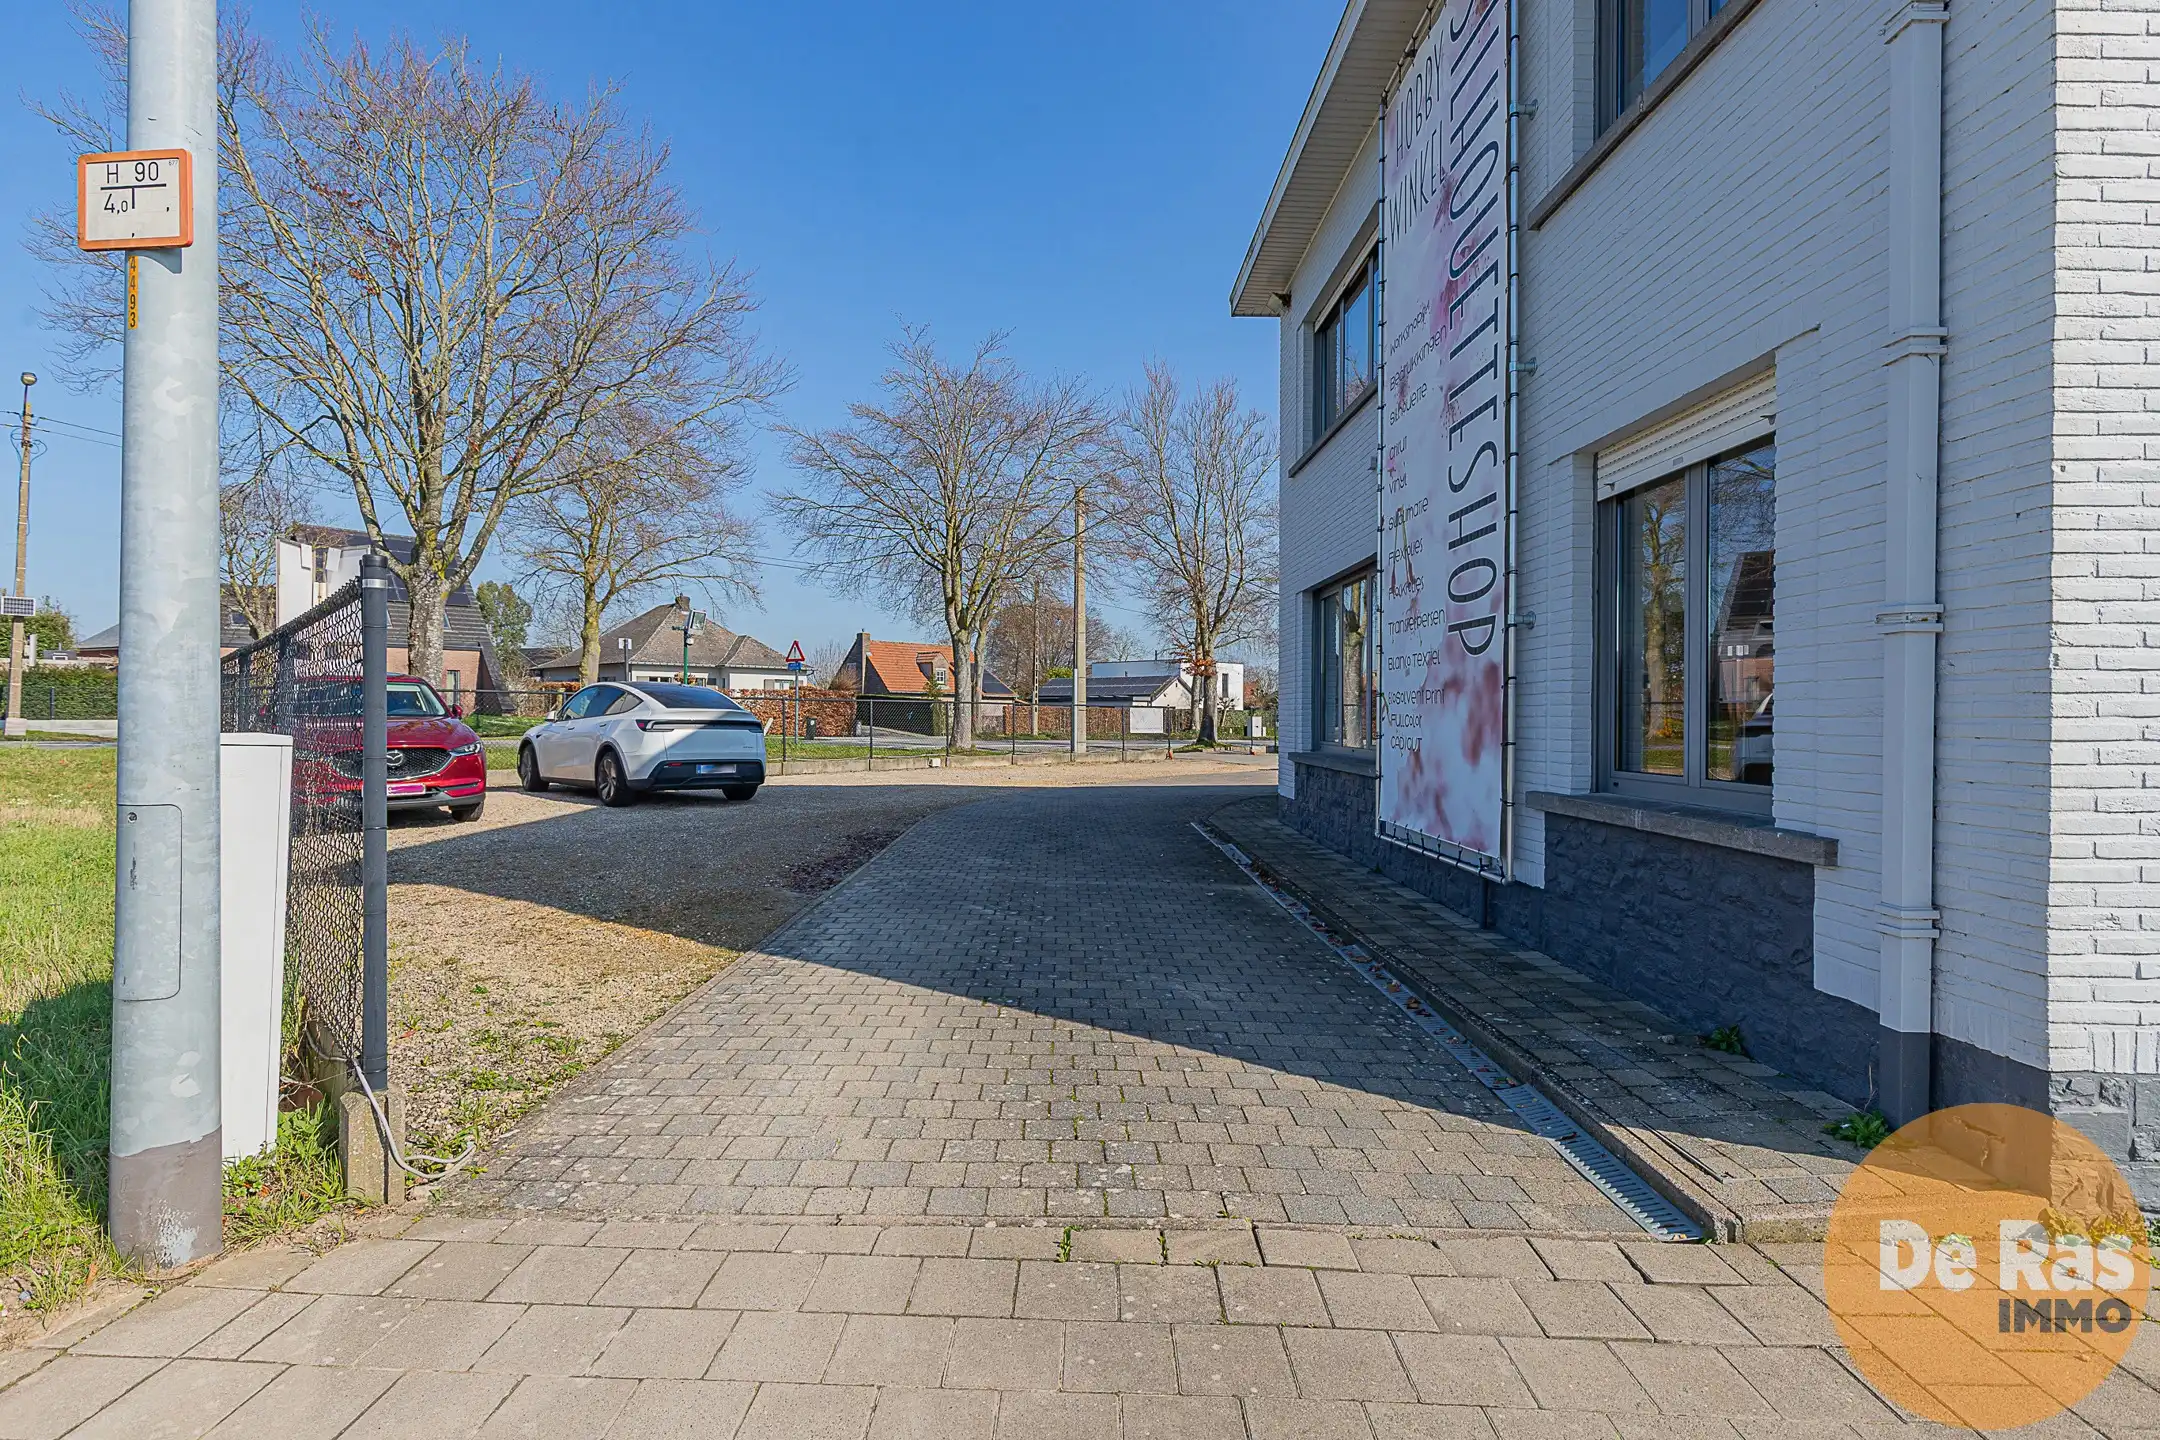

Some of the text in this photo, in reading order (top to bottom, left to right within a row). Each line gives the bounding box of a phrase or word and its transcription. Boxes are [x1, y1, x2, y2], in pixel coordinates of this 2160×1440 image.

[1396, 29, 1444, 168] HOBBY
[106, 161, 159, 184] H 90
[1389, 119, 1446, 251] WINKEL
